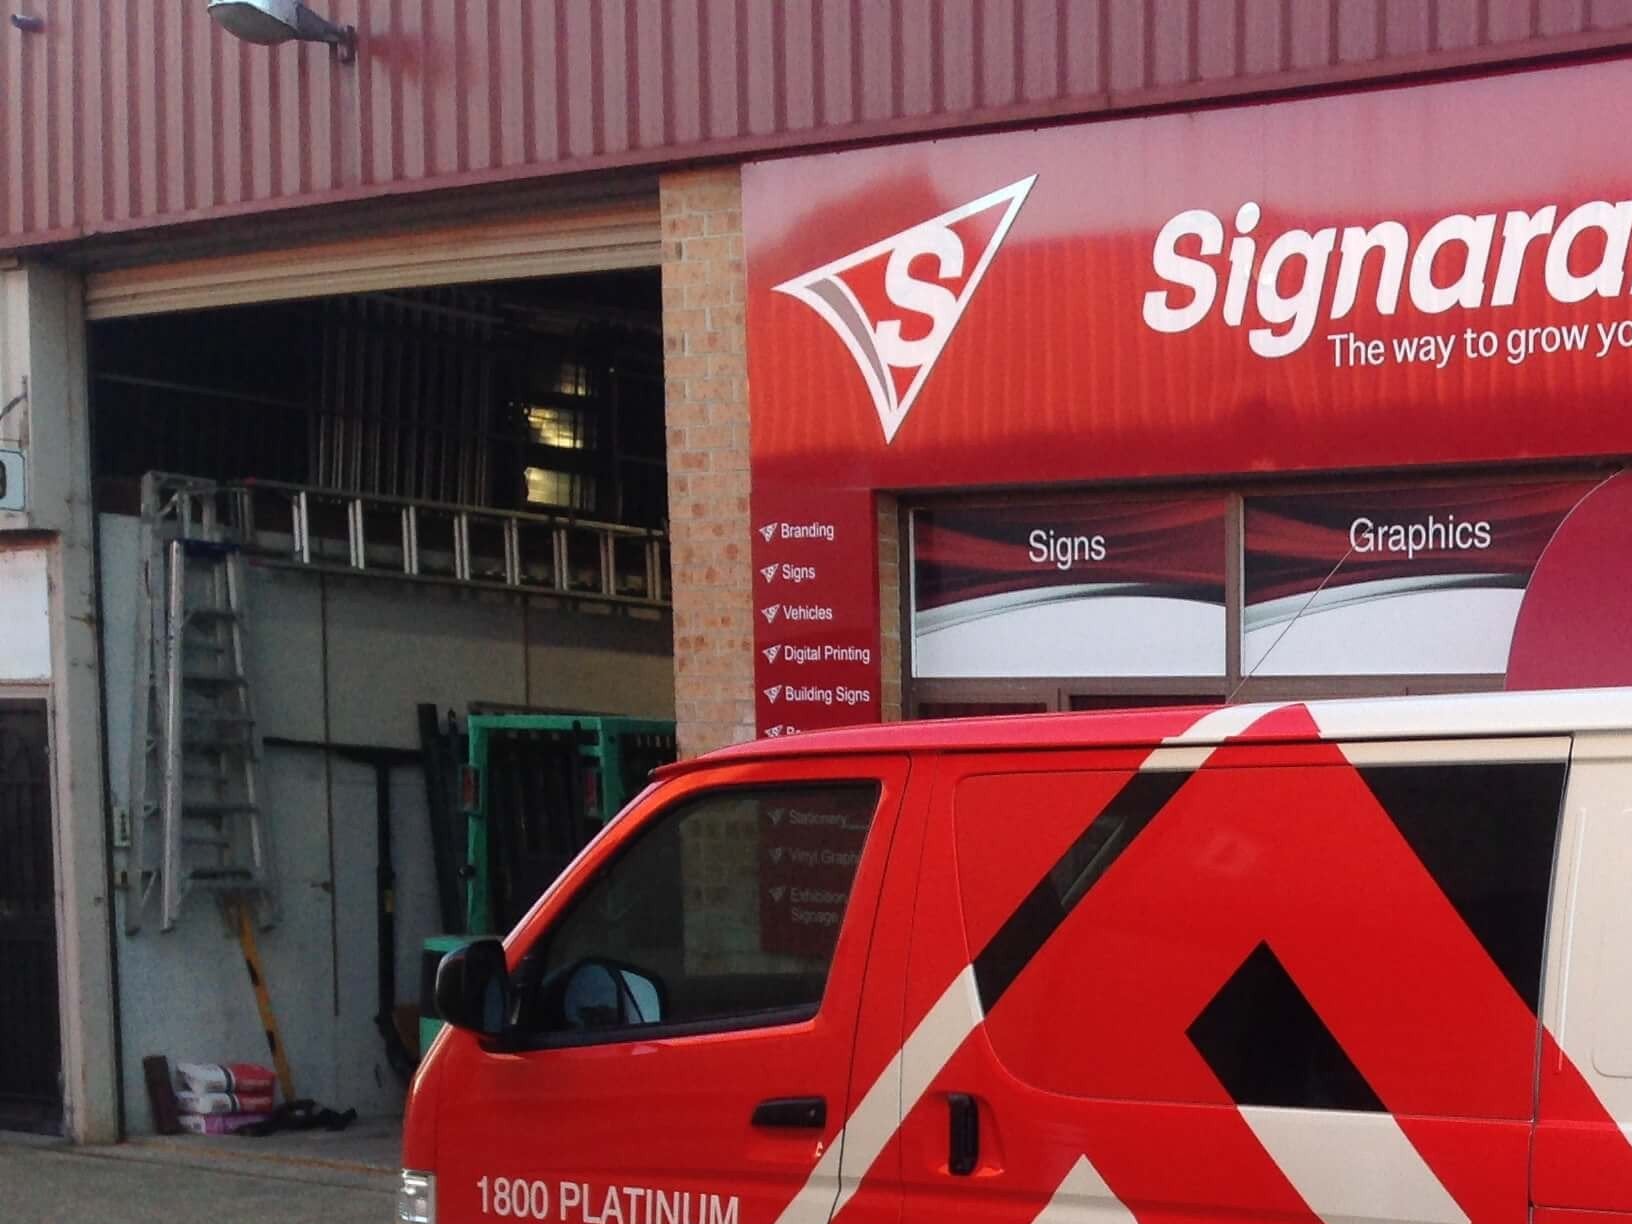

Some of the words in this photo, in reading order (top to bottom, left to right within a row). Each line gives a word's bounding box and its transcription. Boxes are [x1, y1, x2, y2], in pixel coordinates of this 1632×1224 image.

[1327, 333, 1385, 367] The
[1392, 333, 1456, 368] way
[1464, 330, 1497, 359] to
[1507, 321, 1589, 364] grow
[781, 522, 835, 541] Branding
[1349, 514, 1492, 559] Graphics
[1028, 528, 1106, 570] Signs
[782, 563, 816, 582] Signs
[783, 605, 833, 620] Vehicles
[784, 645, 821, 664] Digital
[824, 645, 870, 664] Printing
[785, 686, 833, 705] Building
[836, 685, 870, 705] Signs
[477, 1175, 549, 1220] 1800
